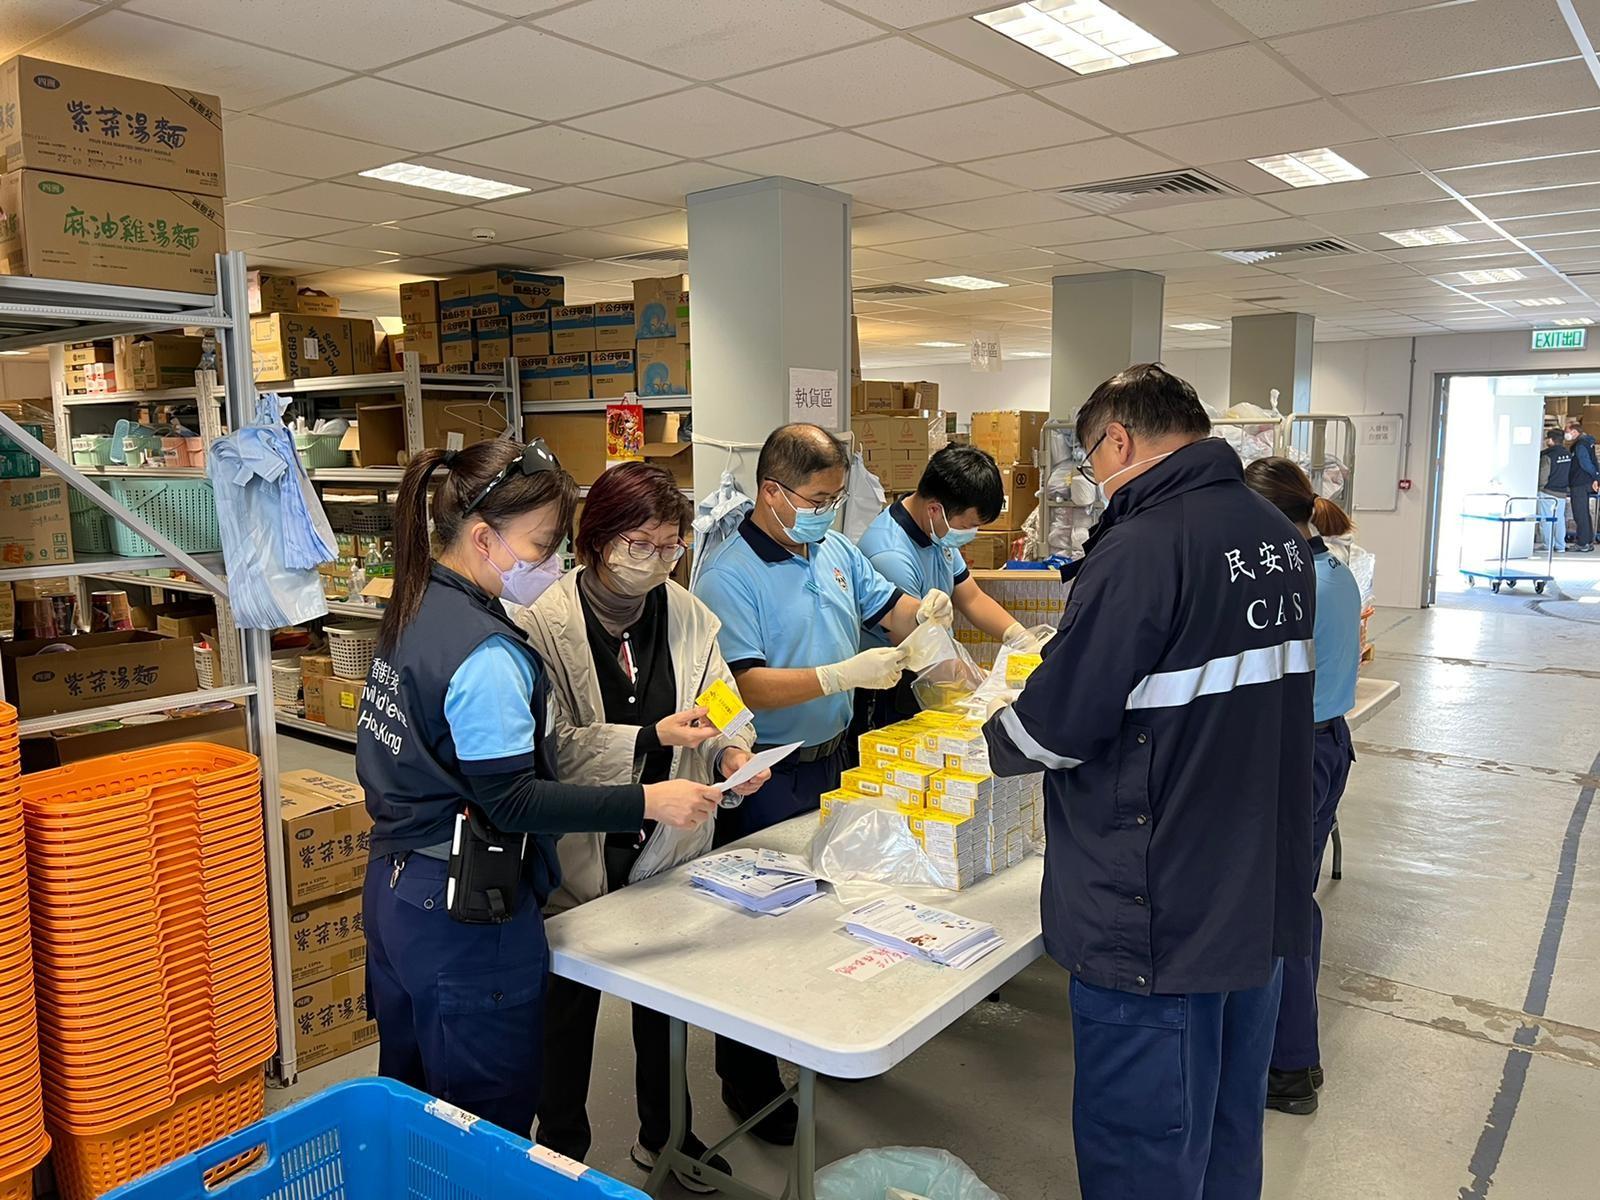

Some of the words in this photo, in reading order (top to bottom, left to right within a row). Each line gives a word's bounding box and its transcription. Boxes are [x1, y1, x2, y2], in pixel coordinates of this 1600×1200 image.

[67, 100, 188, 150] 紫菜湯麵
[64, 206, 200, 251] 麻油雞湯麵
[1536, 332, 1562, 348] EXIT
[1562, 331, 1582, 346] 出口
[795, 387, 833, 409] 執貨區
[1224, 538, 1304, 583] 民安隊
[1246, 592, 1303, 630] CAS
[64, 664, 159, 697] 紫菜湯麵
